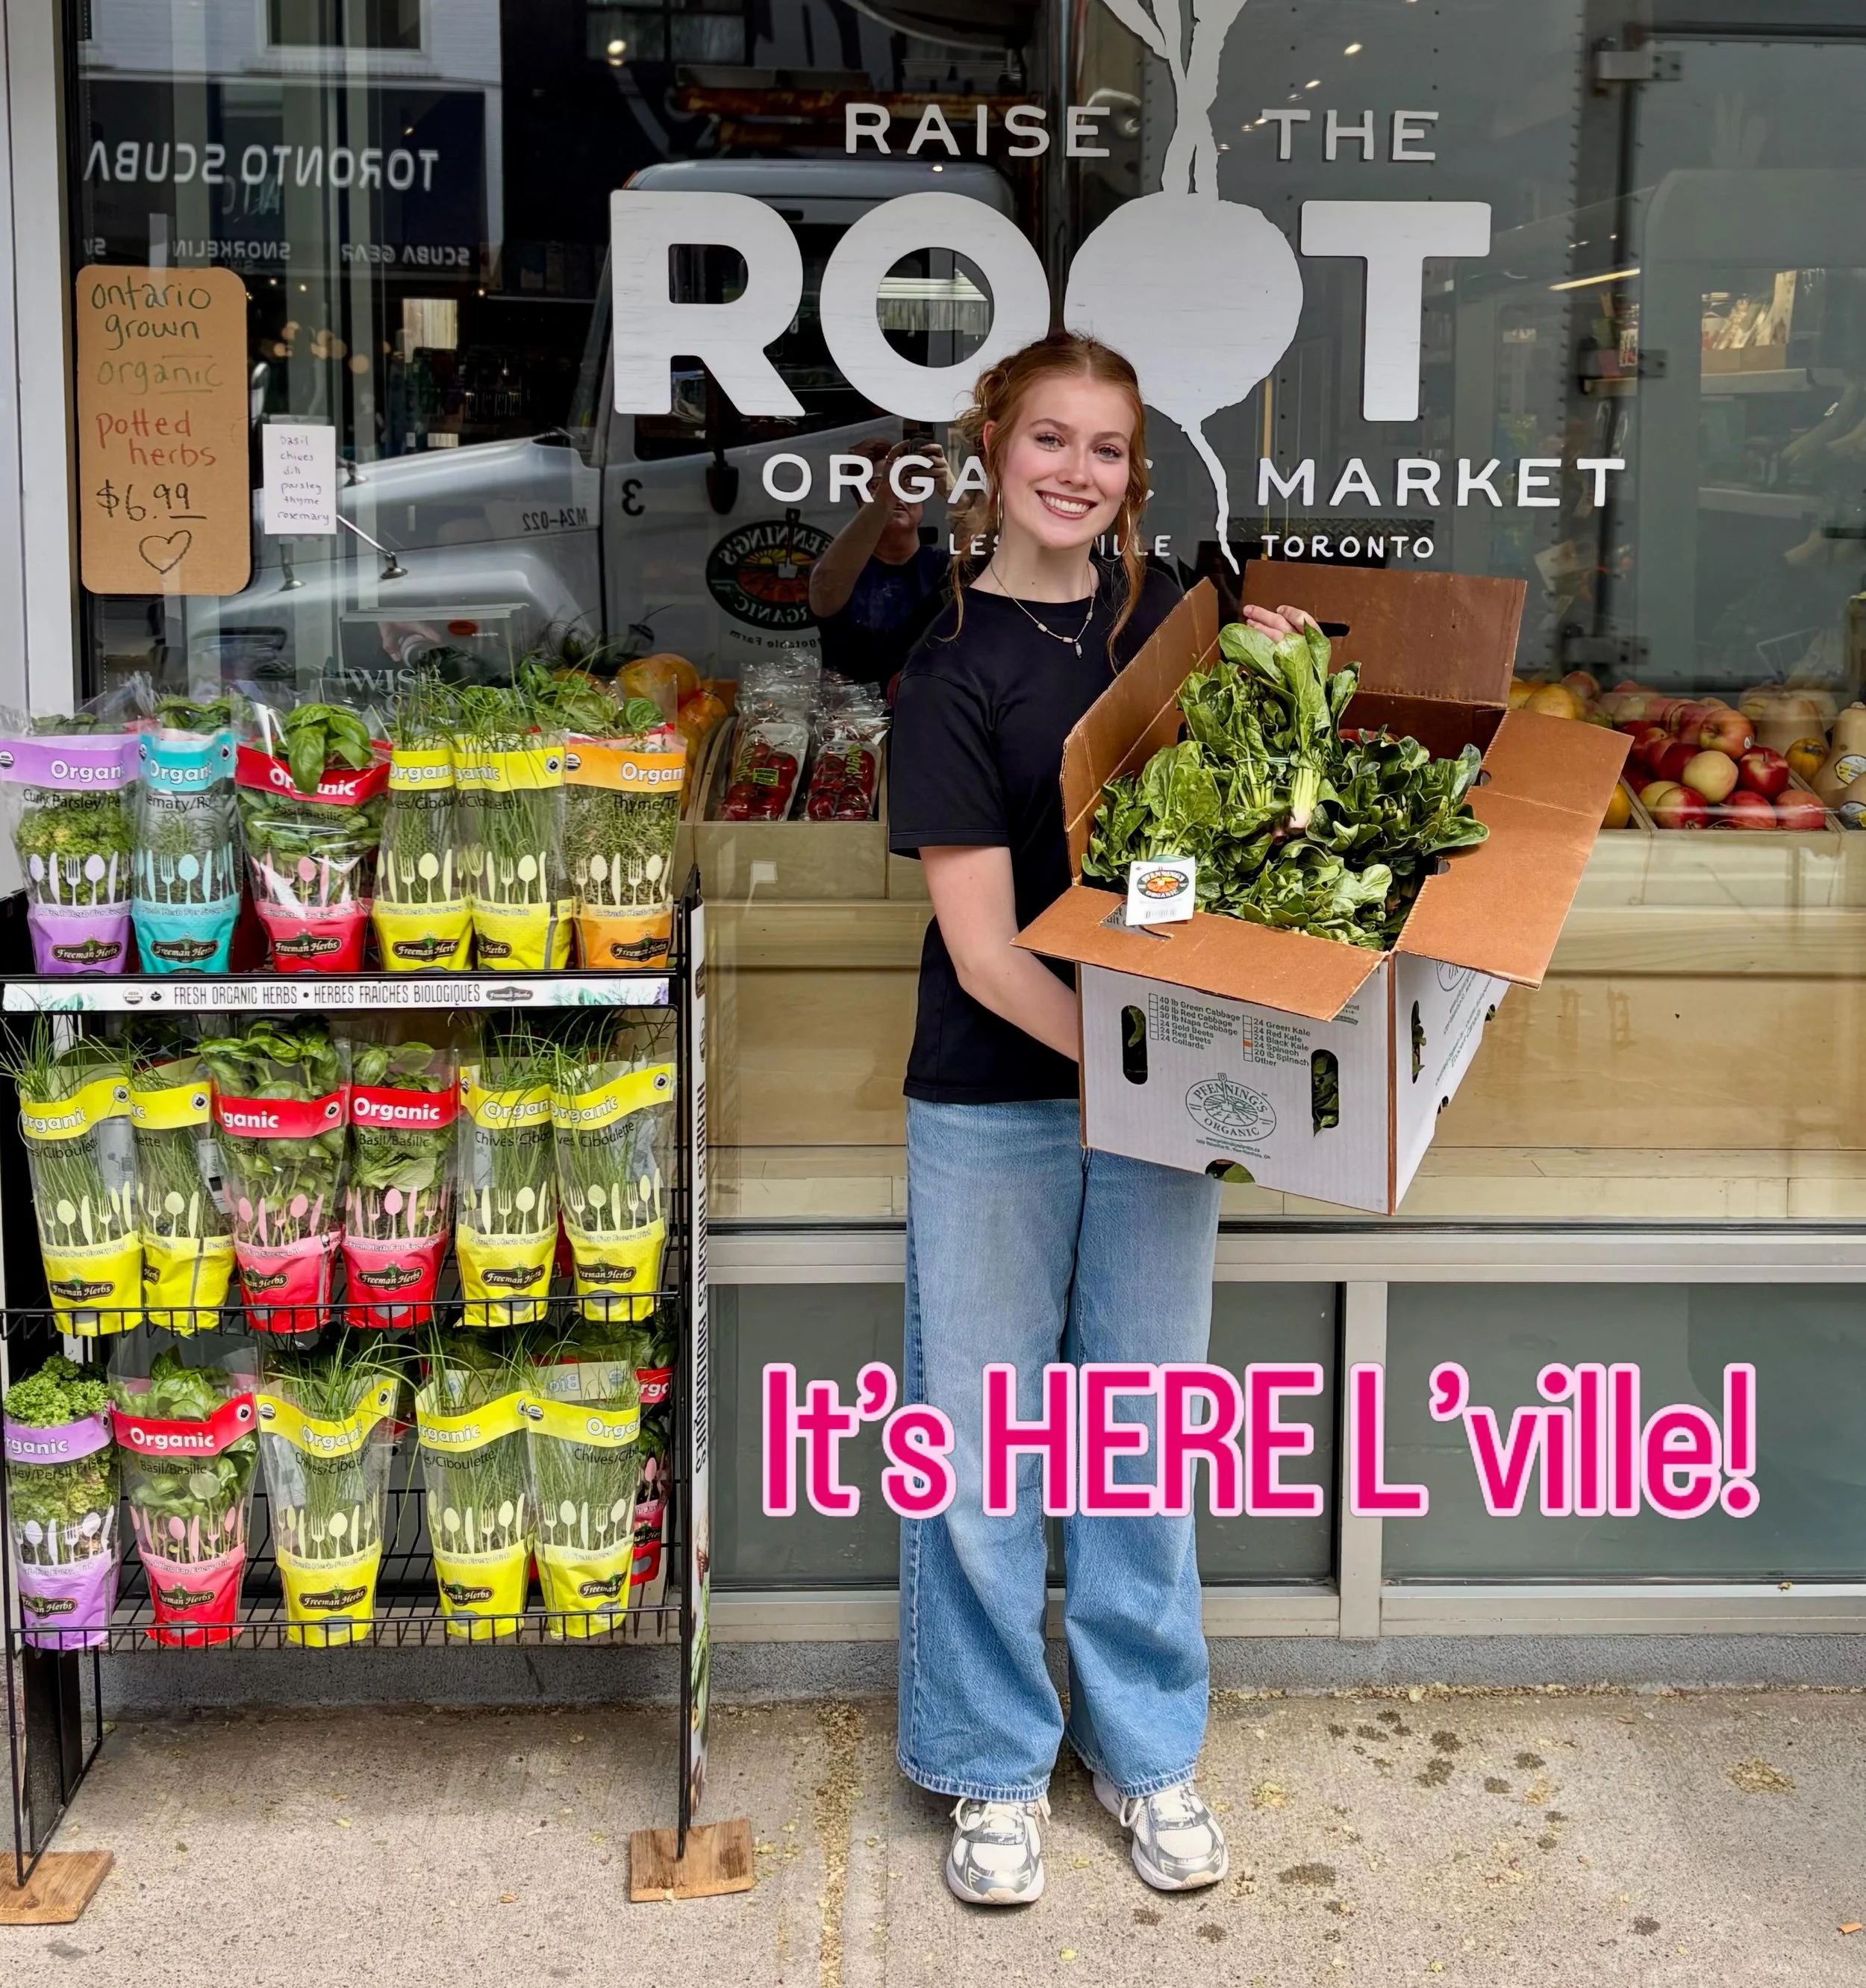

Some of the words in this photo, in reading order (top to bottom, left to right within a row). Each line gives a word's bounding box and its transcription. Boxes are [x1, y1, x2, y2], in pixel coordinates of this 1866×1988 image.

[845, 103, 1111, 157] RAISE
[1261, 108, 1439, 162] THE
[92, 275, 211, 311] ontario
[104, 313, 199, 351] grown
[96, 360, 222, 396] organic
[96, 407, 192, 448] potted
[128, 438, 216, 466] herbs
[280, 450, 314, 461] chives
[281, 481, 322, 495] parsley
[1258, 457, 1626, 508] MARKET
[96, 478, 192, 522] $6.99
[284, 496, 319, 505] thyme
[278, 511, 329, 525] rosemary
[1261, 534, 1435, 559] TORONTO
[454, 763, 501, 783] ganic
[52, 794, 120, 813] Parsley/Pe
[174, 986, 207, 1005] FRESH
[212, 986, 258, 1005] ORGANIC
[263, 986, 298, 1005] HERBS
[314, 985, 354, 1004] HERBES
[414, 984, 480, 1005] BIOLOGIQUES
[1159, 996, 1170, 1004] 40
[1181, 1001, 1204, 1013] Green
[1205, 1007, 1241, 1022] Cabbage
[1181, 1008, 1196, 1019] Red
[1198, 1013, 1232, 1028] Cabbage
[1172, 1029, 1187, 1039] Red
[1203, 1022, 1238, 1036] Cabbage
[1254, 1018, 1264, 1026] 24
[1266, 1022, 1291, 1032] Green
[1293, 1025, 1311, 1037] Kale
[1267, 1030, 1282, 1039] Red
[1284, 1033, 1302, 1043] Kale
[1172, 1037, 1205, 1050] Collards
[1267, 1044, 1299, 1057] Spinach
[1291, 1041, 1309, 1051] Kale
[1276, 1054, 1309, 1066] Spinach
[1193, 1082, 1268, 1113] PFENNING'S
[354, 1097, 440, 1121] Organic
[222, 1110, 279, 1128] ganic
[1204, 1118, 1260, 1137] ORGANIC
[359, 1134, 430, 1147] Basil/Basilic
[130, 1427, 215, 1450] Organic
[418, 1424, 481, 1443] rganic
[4, 1437, 69, 1454] rganic
[140, 1460, 207, 1475] Basil/Basilic
[464, 1589, 490, 1601] Herbs
[46, 1601, 72, 1612] Herbs
